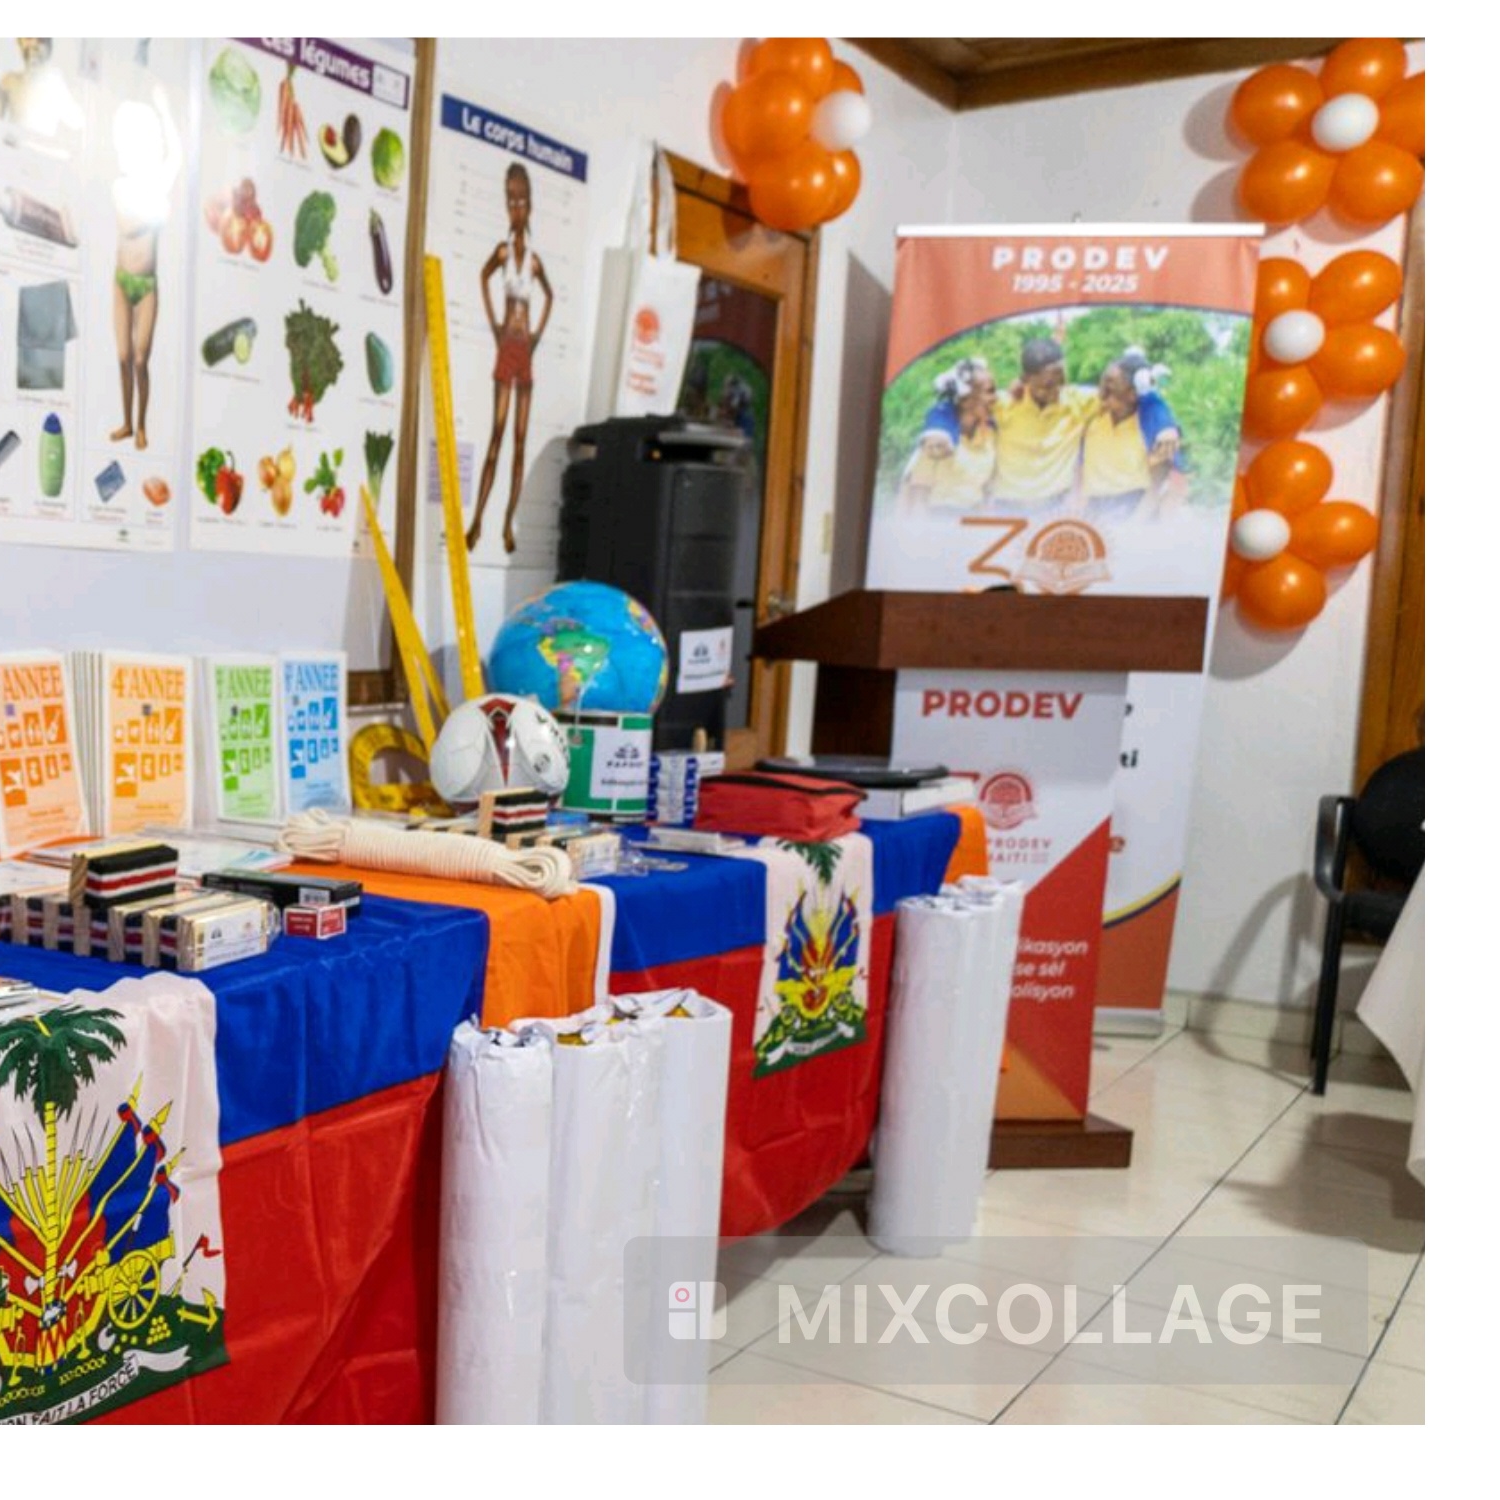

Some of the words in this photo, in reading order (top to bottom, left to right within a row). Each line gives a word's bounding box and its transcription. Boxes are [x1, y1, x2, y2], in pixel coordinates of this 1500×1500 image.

[484, 121, 525, 153] corps
[991, 245, 1169, 271] PRODEV
[1012, 274, 1063, 293] 1995
[1081, 274, 1140, 293] 2025
[2, 665, 64, 700] ANNEE
[128, 666, 185, 701] ANNEE
[921, 689, 1084, 720] PRODEV
[1018, 937, 1089, 957] ikasyon
[1011, 981, 1075, 1002] olisyon
[89, 1360, 139, 1404] FORCE
